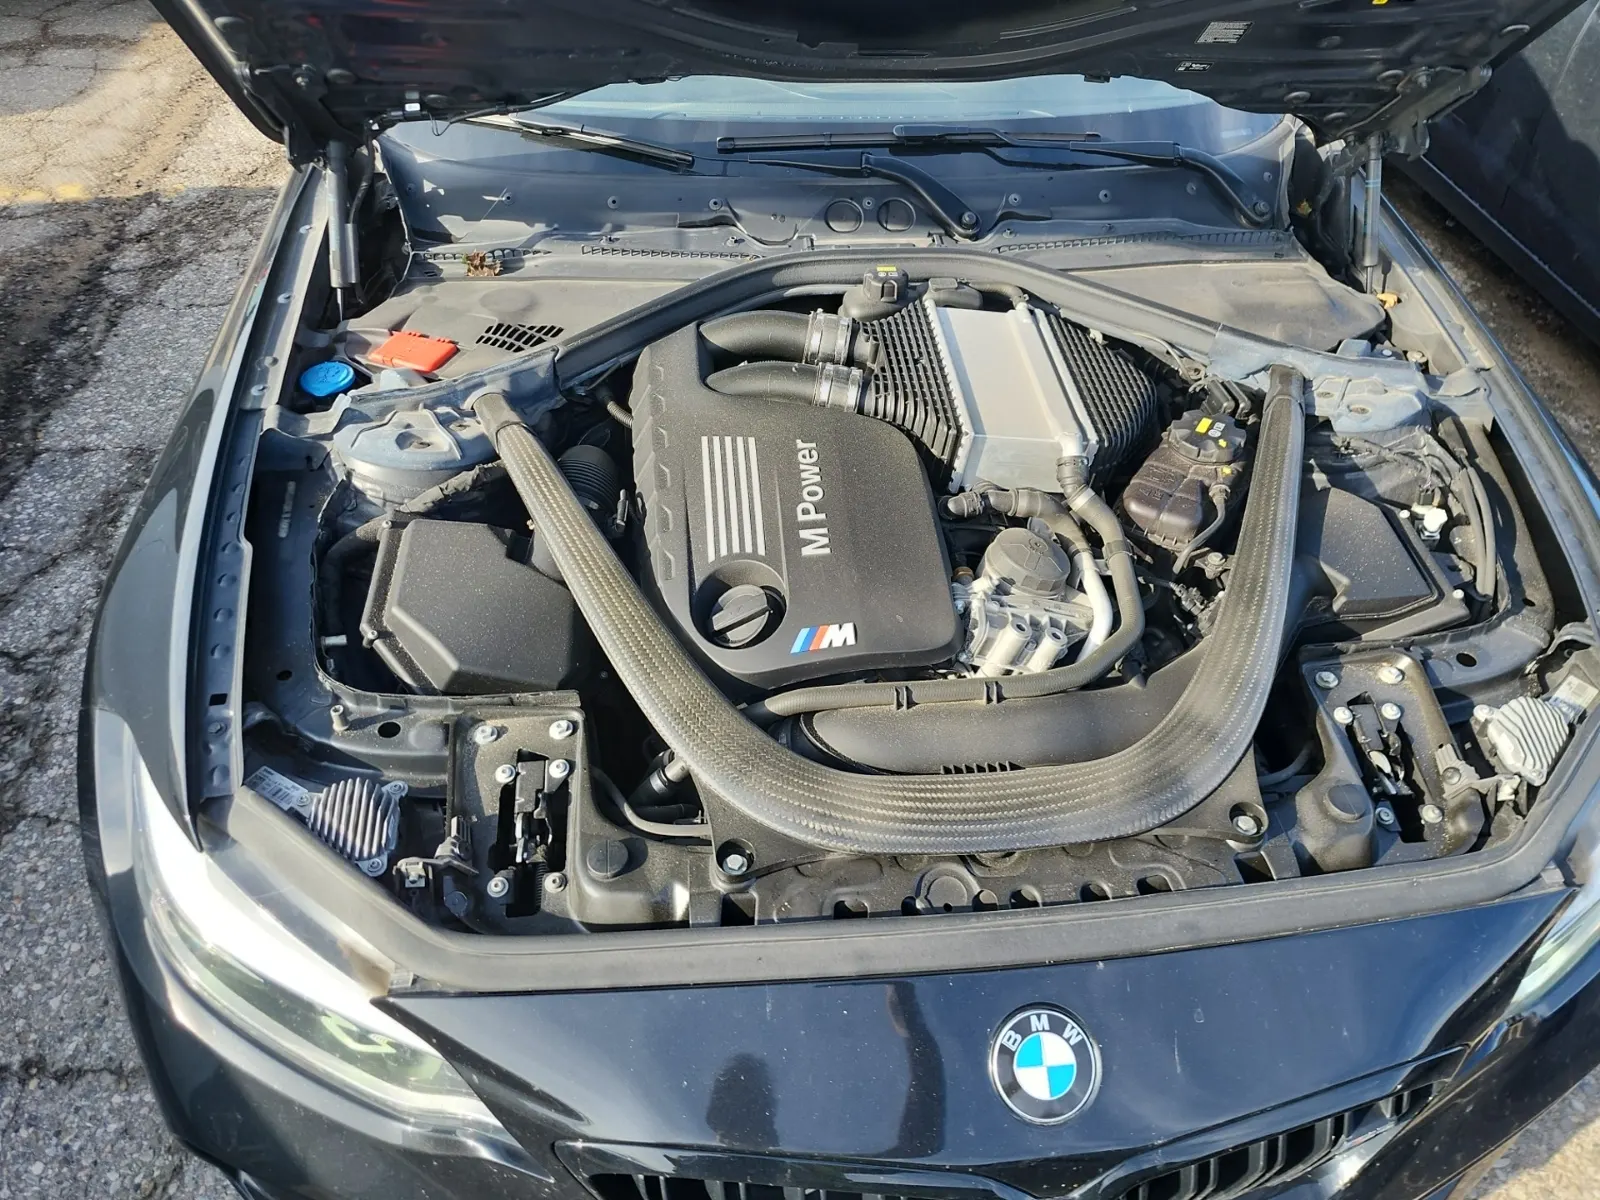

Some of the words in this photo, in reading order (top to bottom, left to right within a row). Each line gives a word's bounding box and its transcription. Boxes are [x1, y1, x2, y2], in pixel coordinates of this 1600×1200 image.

[796, 439, 827, 521] Power
[798, 527, 832, 556] M
[1001, 1013, 1083, 1052] BMW
